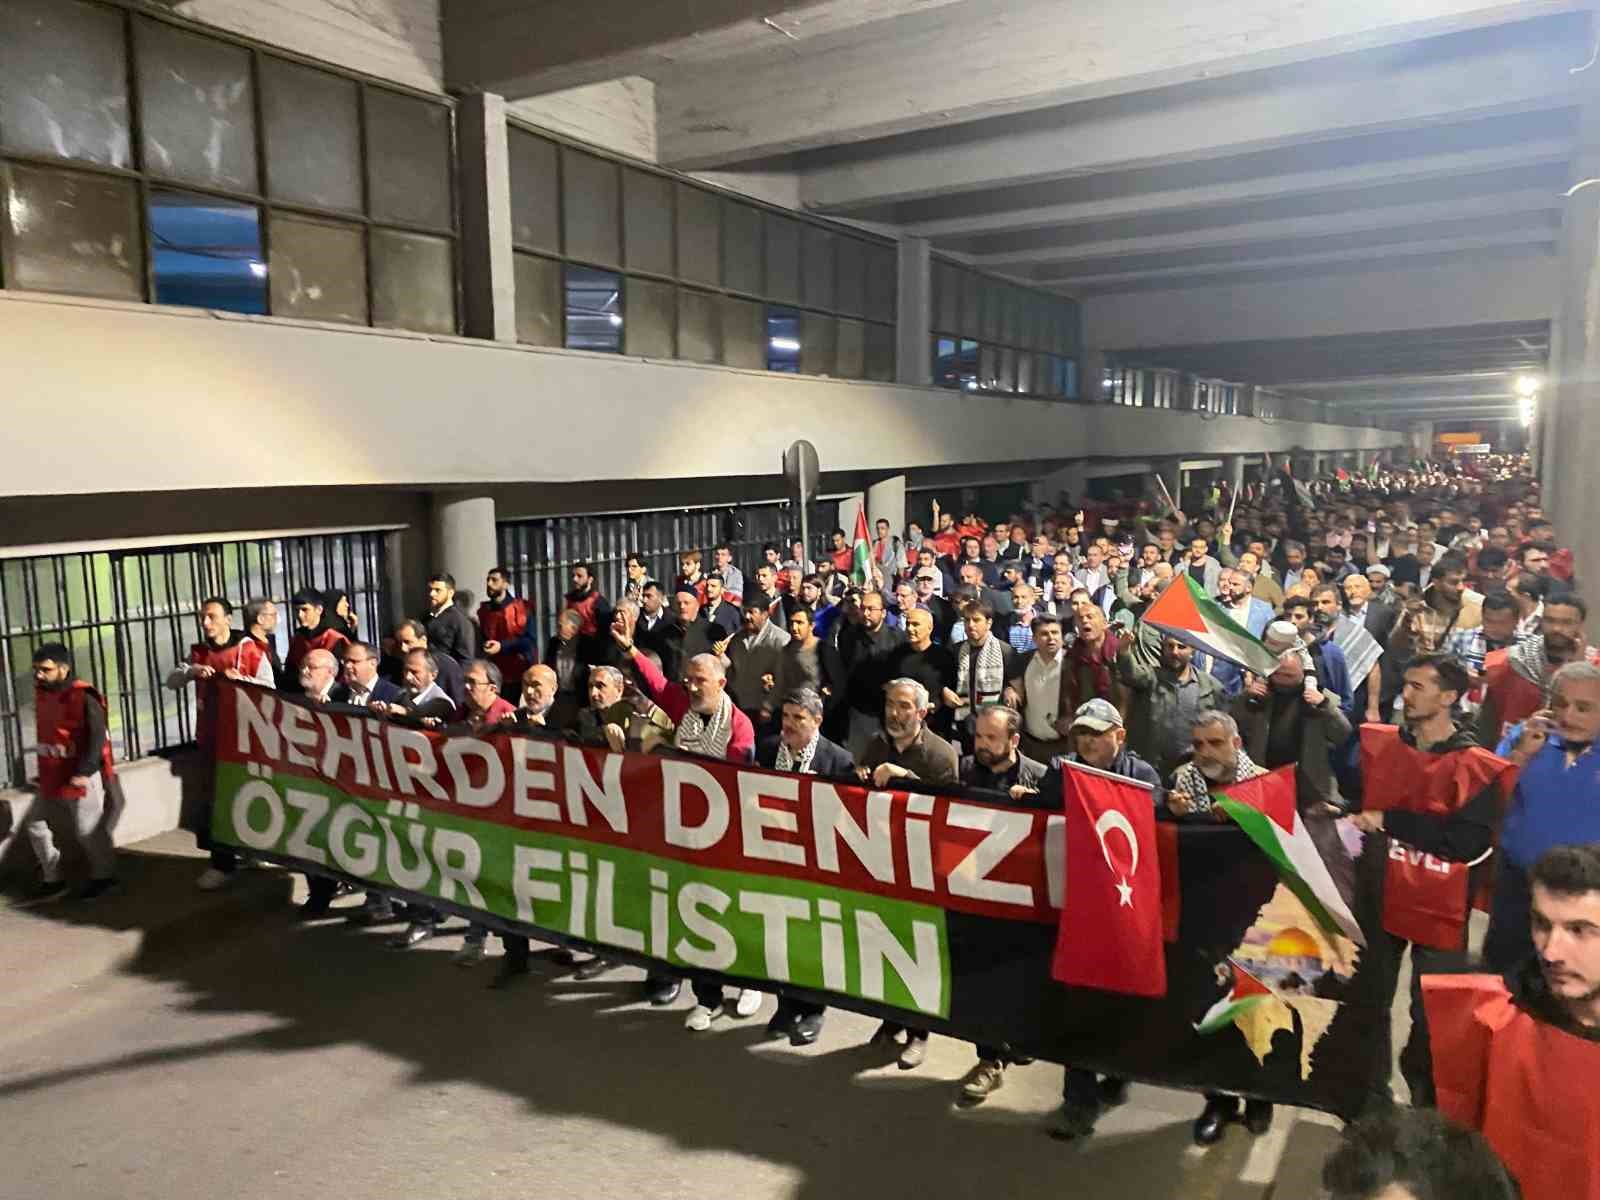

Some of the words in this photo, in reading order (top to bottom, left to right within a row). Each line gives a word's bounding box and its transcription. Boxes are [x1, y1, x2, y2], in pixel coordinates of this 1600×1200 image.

[234, 687, 629, 834] NEHİRDEN
[231, 763, 488, 911] ÖZGÜR
[513, 844, 942, 1016] FİLİSTİN
